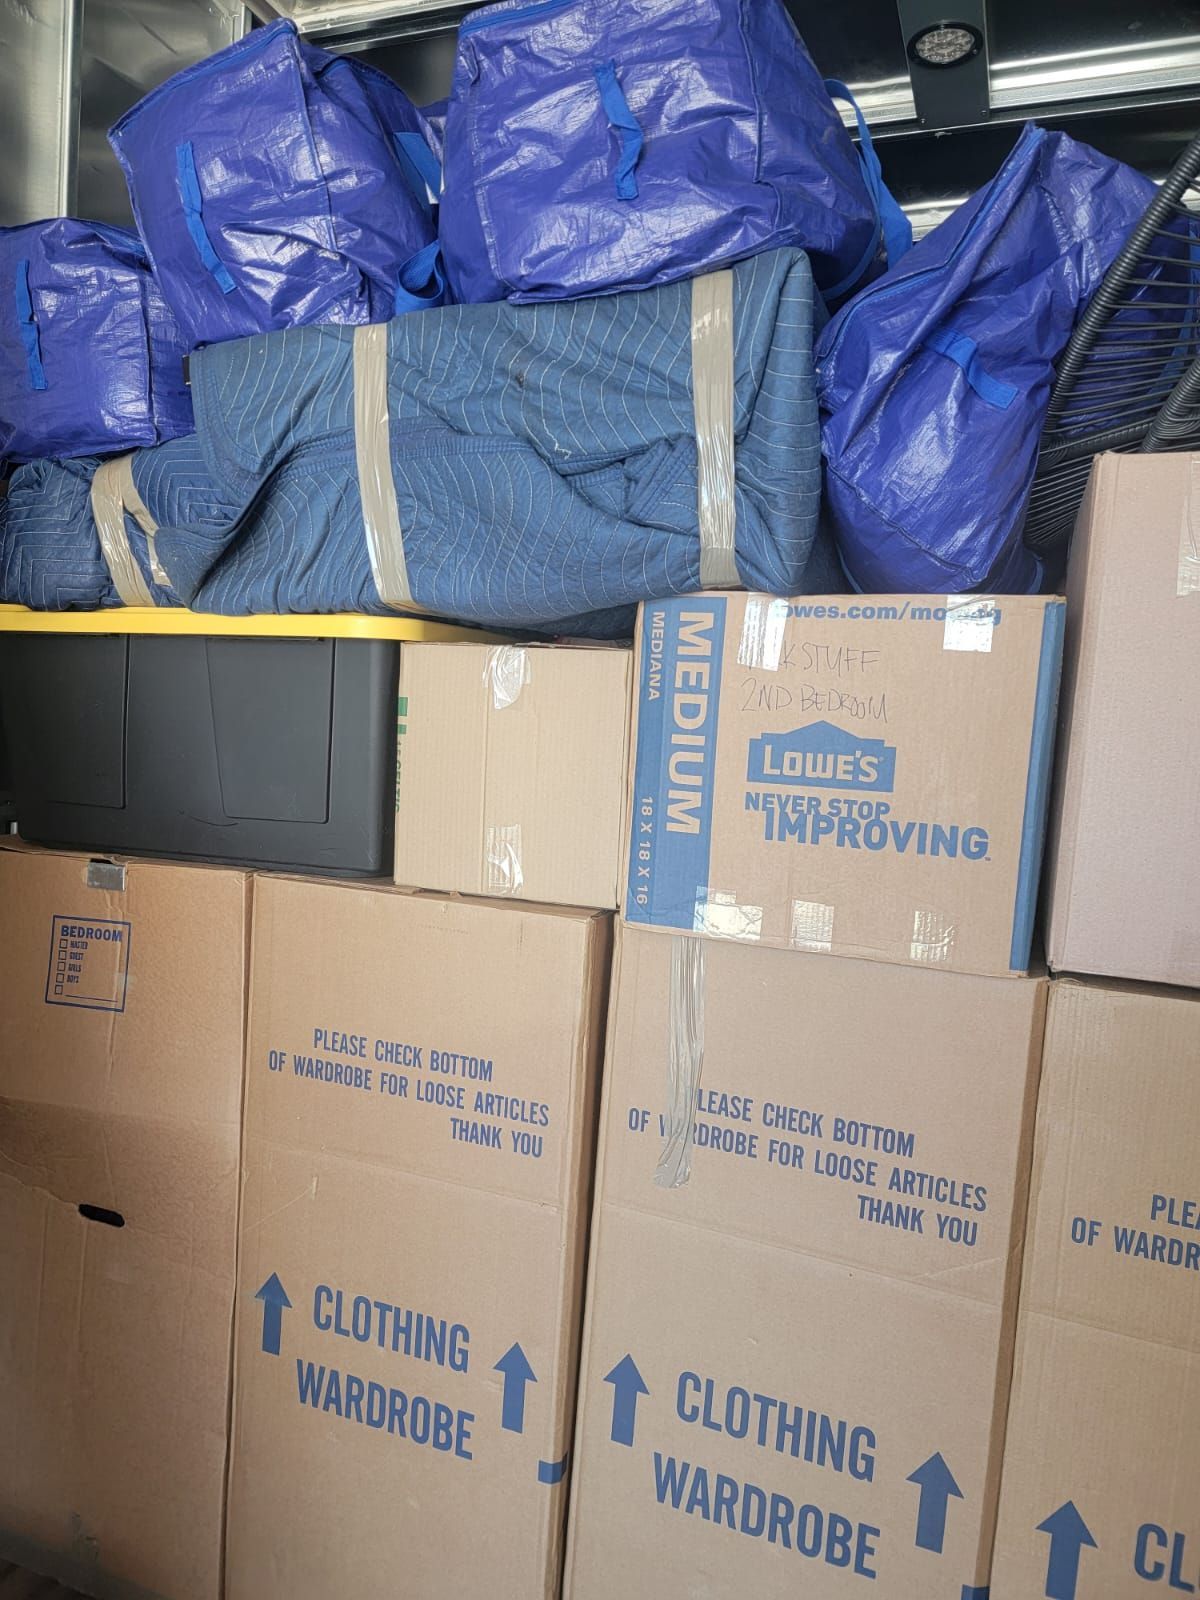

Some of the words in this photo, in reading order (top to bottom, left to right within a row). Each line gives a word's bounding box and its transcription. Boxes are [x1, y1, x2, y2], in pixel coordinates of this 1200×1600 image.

[648, 611, 666, 700] MEDIANA
[802, 641, 881, 677] STUFF
[665, 612, 714, 835] MEDIUM
[741, 677, 793, 712] 2ND
[800, 683, 888, 724] BEDROOM
[763, 744, 879, 783] LOWE'S
[641, 796, 653, 816] 18
[744, 791, 822, 816] NEVER
[827, 798, 891, 821] STOP
[639, 841, 651, 861] 18
[764, 807, 989, 860] IMPROVING
[636, 885, 649, 905] 16
[61, 925, 123, 942] BEDROOM
[314, 1028, 368, 1058] PLEASE
[374, 1039, 423, 1069] CHECK
[430, 1050, 493, 1082] BOTTOM
[269, 1050, 287, 1072] OF
[293, 1054, 372, 1090] WARDROBE
[380, 1072, 409, 1098] FOR
[416, 1080, 466, 1110] LOOSE
[474, 1091, 549, 1127] ARTICLES
[450, 1117, 502, 1149] THANK
[511, 1130, 543, 1158] YOU
[697, 1088, 753, 1122] LEASE
[762, 1102, 824, 1138] CHECK
[833, 1117, 915, 1158] BOTTOM
[628, 1108, 651, 1132] OF
[768, 1139, 805, 1169] FOR
[814, 1150, 878, 1187] LOOSE
[888, 1167, 988, 1212] ARTICLES
[857, 1194, 924, 1234] THANK
[936, 1213, 978, 1247] YOU
[1071, 1216, 1102, 1246] OF
[313, 1284, 470, 1374] CLOTHING
[296, 1358, 475, 1460] WARDROBE
[676, 1371, 876, 1483] CLOTHING
[653, 1451, 881, 1579] WARDROBE
[1134, 1523, 1200, 1594] CL
